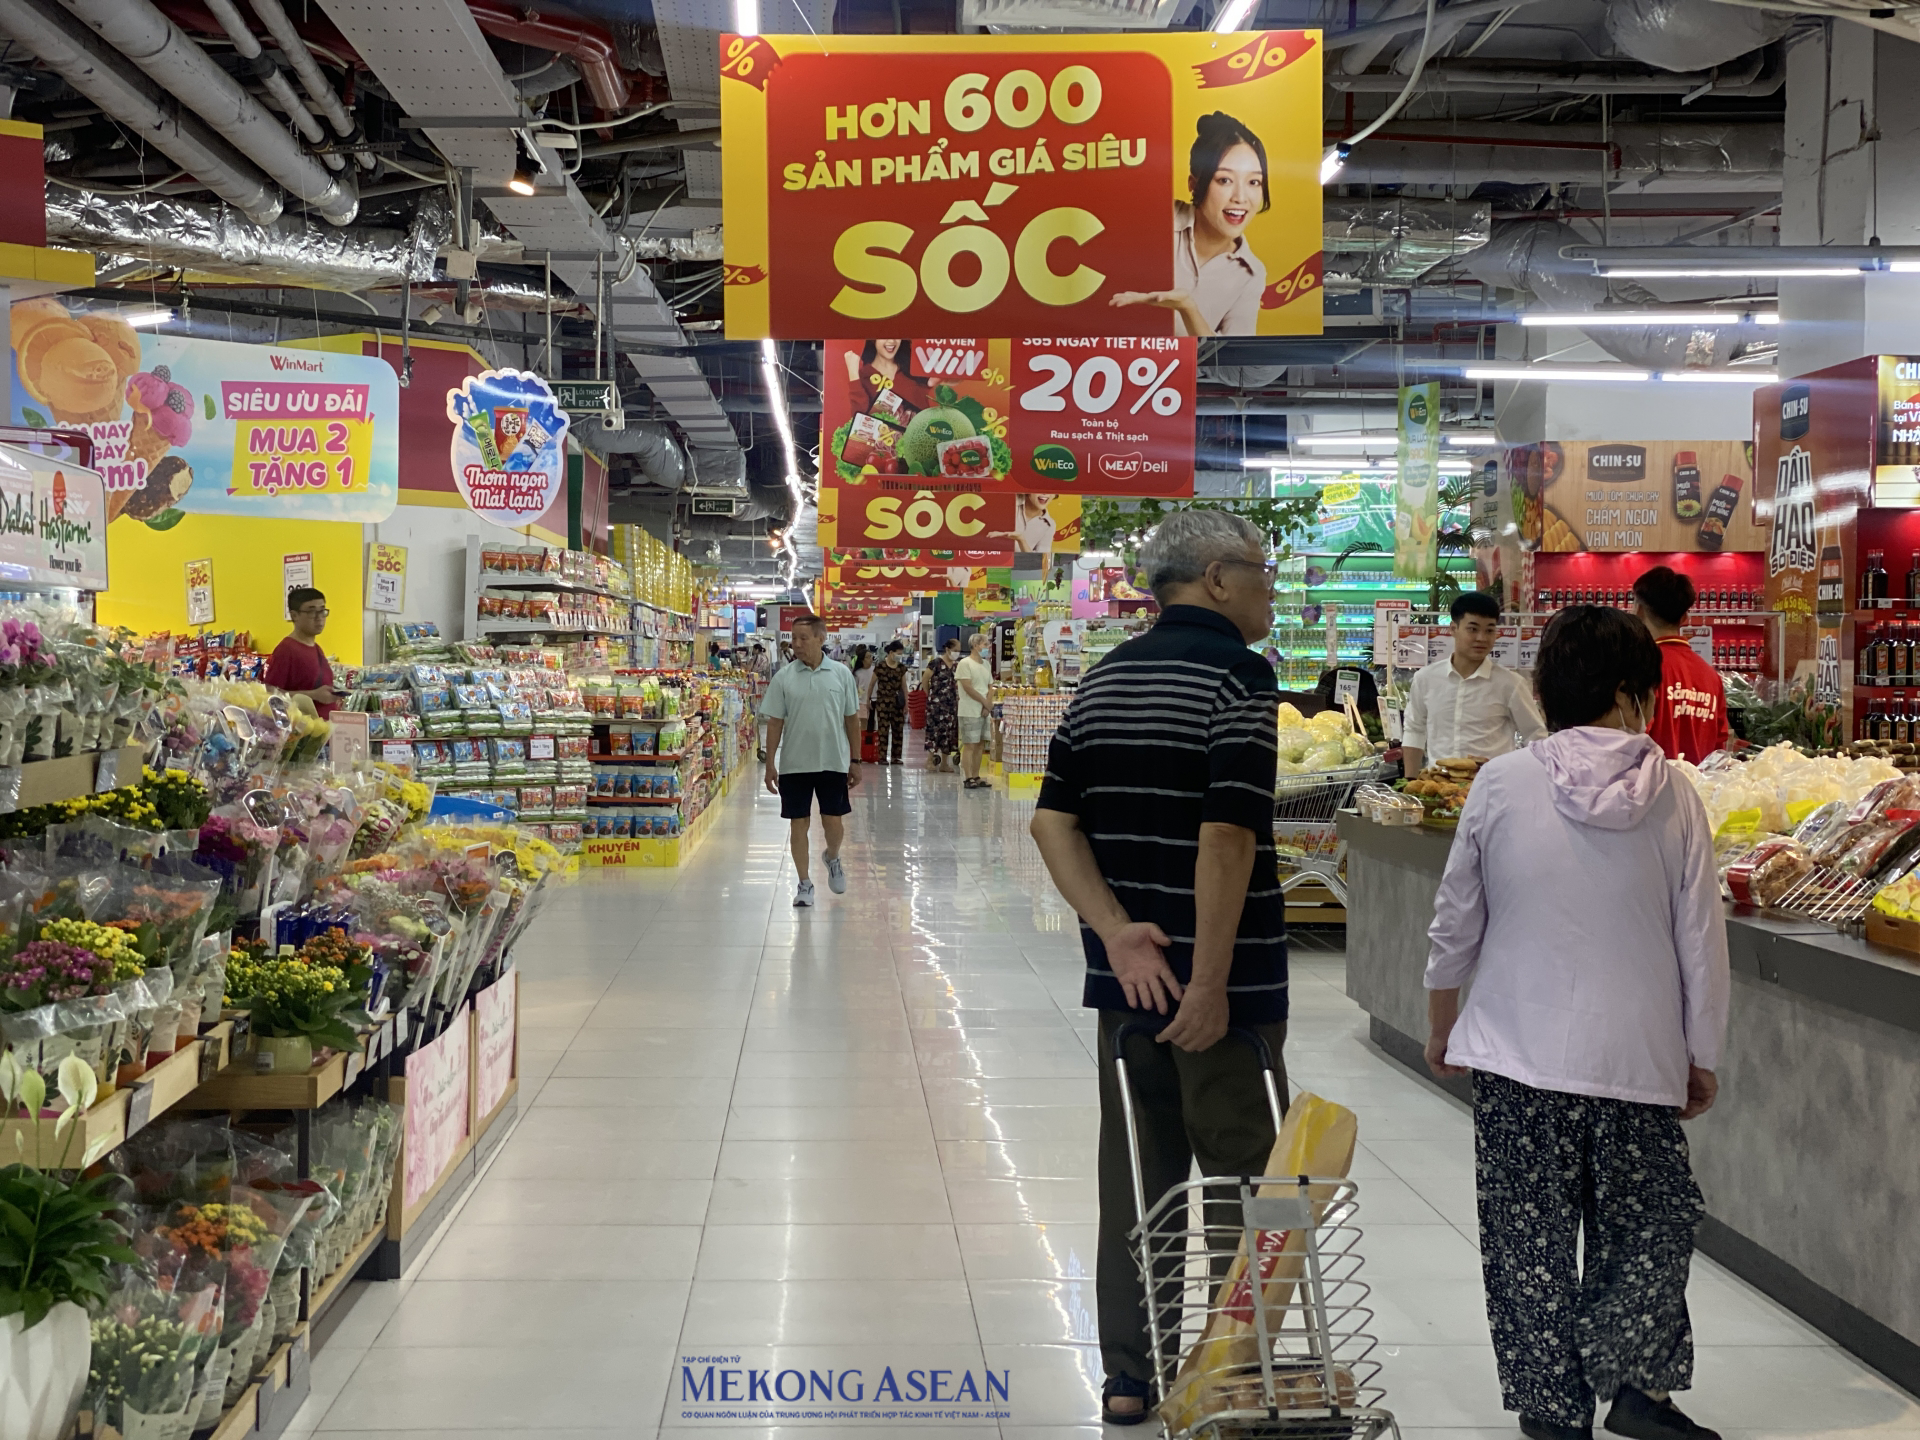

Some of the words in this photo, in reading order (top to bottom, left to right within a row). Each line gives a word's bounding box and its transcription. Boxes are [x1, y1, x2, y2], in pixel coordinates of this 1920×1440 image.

[825, 97, 931, 141] HƠN
[944, 65, 1103, 133] 600
[783, 150, 862, 191] SẢN
[872, 138, 980, 185] PHẨM
[989, 138, 1055, 177] GIÁ
[1062, 132, 1147, 172] SIÊU
[829, 181, 1106, 320] SỐC
[1022, 337, 1052, 346] 365
[270, 355, 324, 373] WinMart
[1020, 354, 1182, 416] 20%
[228, 388, 281, 412] SIÊU
[286, 390, 319, 412] ƯU
[324, 389, 363, 412] ĐÃI
[578, 399, 601, 408] EXIT
[1782, 397, 1809, 420] CHIN-SU
[1894, 400, 1914, 410] Bán
[1081, 418, 1104, 428] Toàn
[1106, 418, 1119, 429] bộ
[1893, 413, 1907, 425] tại
[93, 423, 131, 441] NAY
[249, 427, 317, 453] MUA
[325, 422, 349, 453] 2
[1050, 430, 1070, 439] Rau
[1071, 431, 1094, 441] sạch
[1095, 431, 1103, 440] &
[1105, 432, 1125, 442] Thịt
[1126, 433, 1149, 443] sạch
[95, 441, 127, 460] GÀY
[1034, 458, 1075, 471] WinEco
[1105, 460, 1139, 471] MEAT
[1142, 461, 1168, 473] Deli
[1592, 455, 1642, 467] CHIN-SU
[249, 456, 327, 494] TẶNG
[336, 456, 353, 486] 1
[466, 466, 508, 487] Thơm
[510, 472, 547, 492] ngon
[472, 486, 506, 508] Mát
[508, 490, 542, 514] lạnh
[1586, 505, 1621, 525] CHẤM
[1625, 509, 1657, 525] NGON
[1586, 531, 1610, 549] VẠN
[1614, 528, 1643, 547] MÓN
[377, 555, 402, 572] SỐC
[1818, 584, 1844, 601] CHIN-SU
[1521, 651, 1531, 659] 11
[588, 840, 640, 854] KHUYẾN
